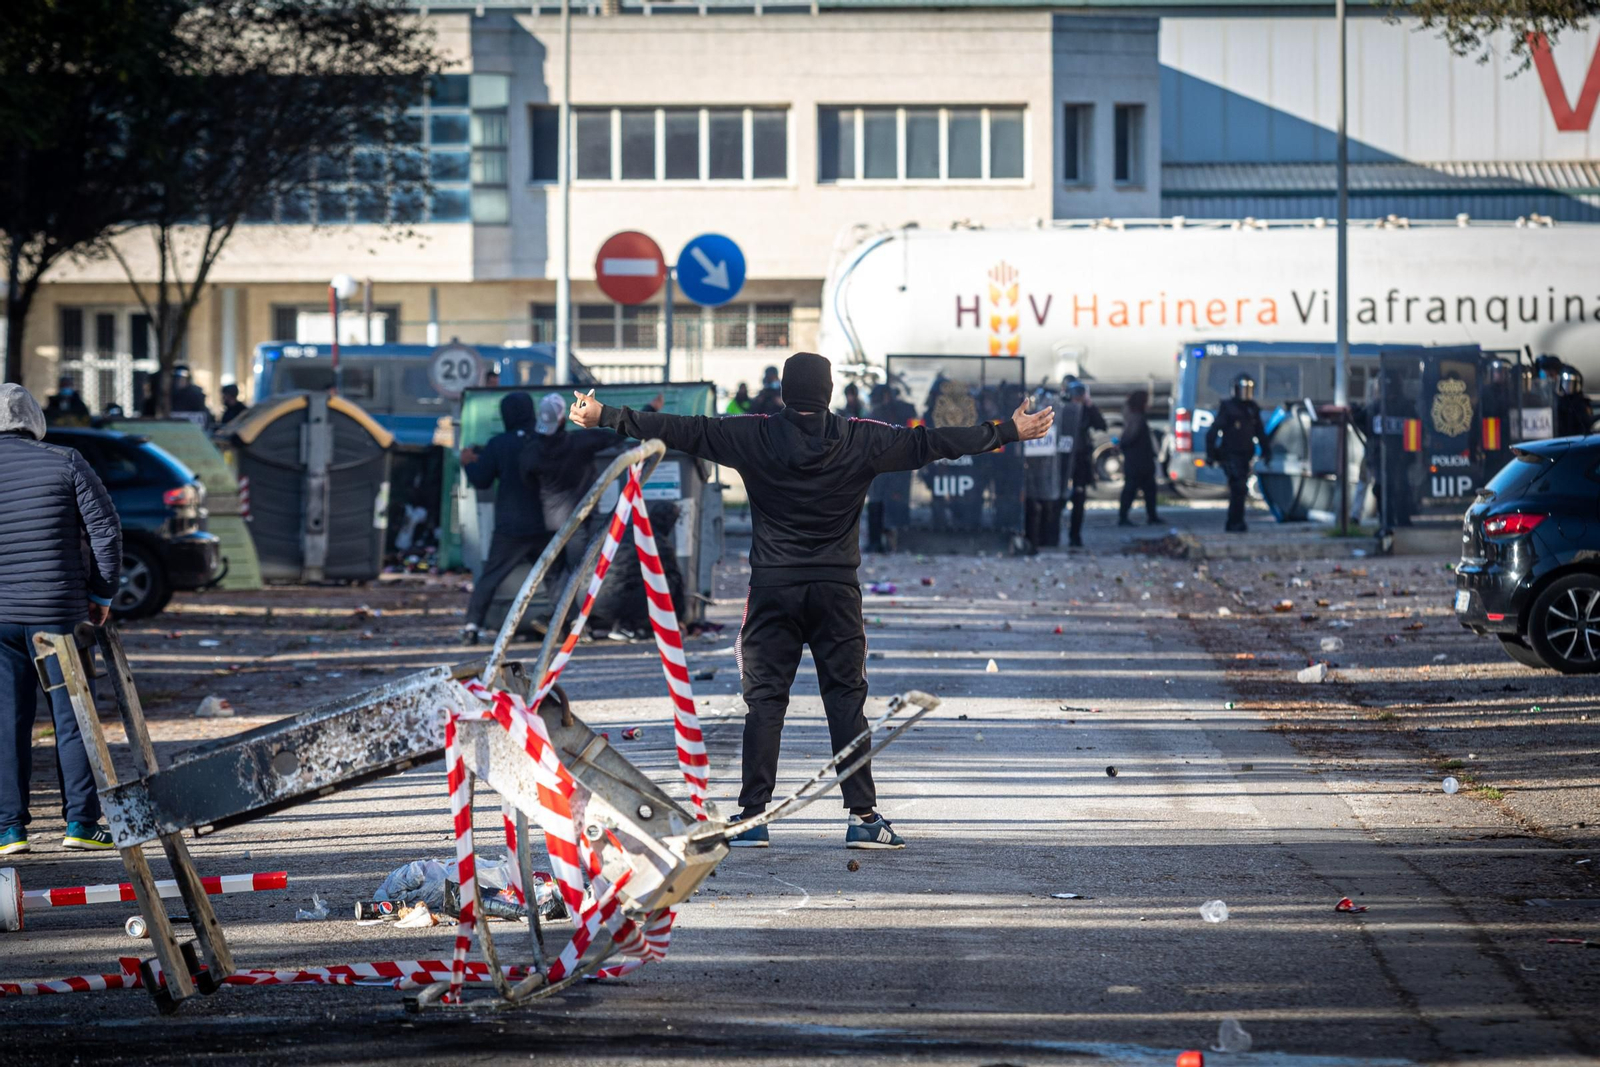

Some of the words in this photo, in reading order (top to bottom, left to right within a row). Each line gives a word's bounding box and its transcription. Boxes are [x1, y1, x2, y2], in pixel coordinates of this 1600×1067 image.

[956, 294, 981, 328] H
[1028, 294, 1053, 327] V
[1073, 290, 1279, 328] Harinera
[1291, 287, 1600, 331] Viafranquin
[441, 358, 472, 380] 20
[933, 475, 975, 497] UIP
[1431, 475, 1473, 497] UIP
